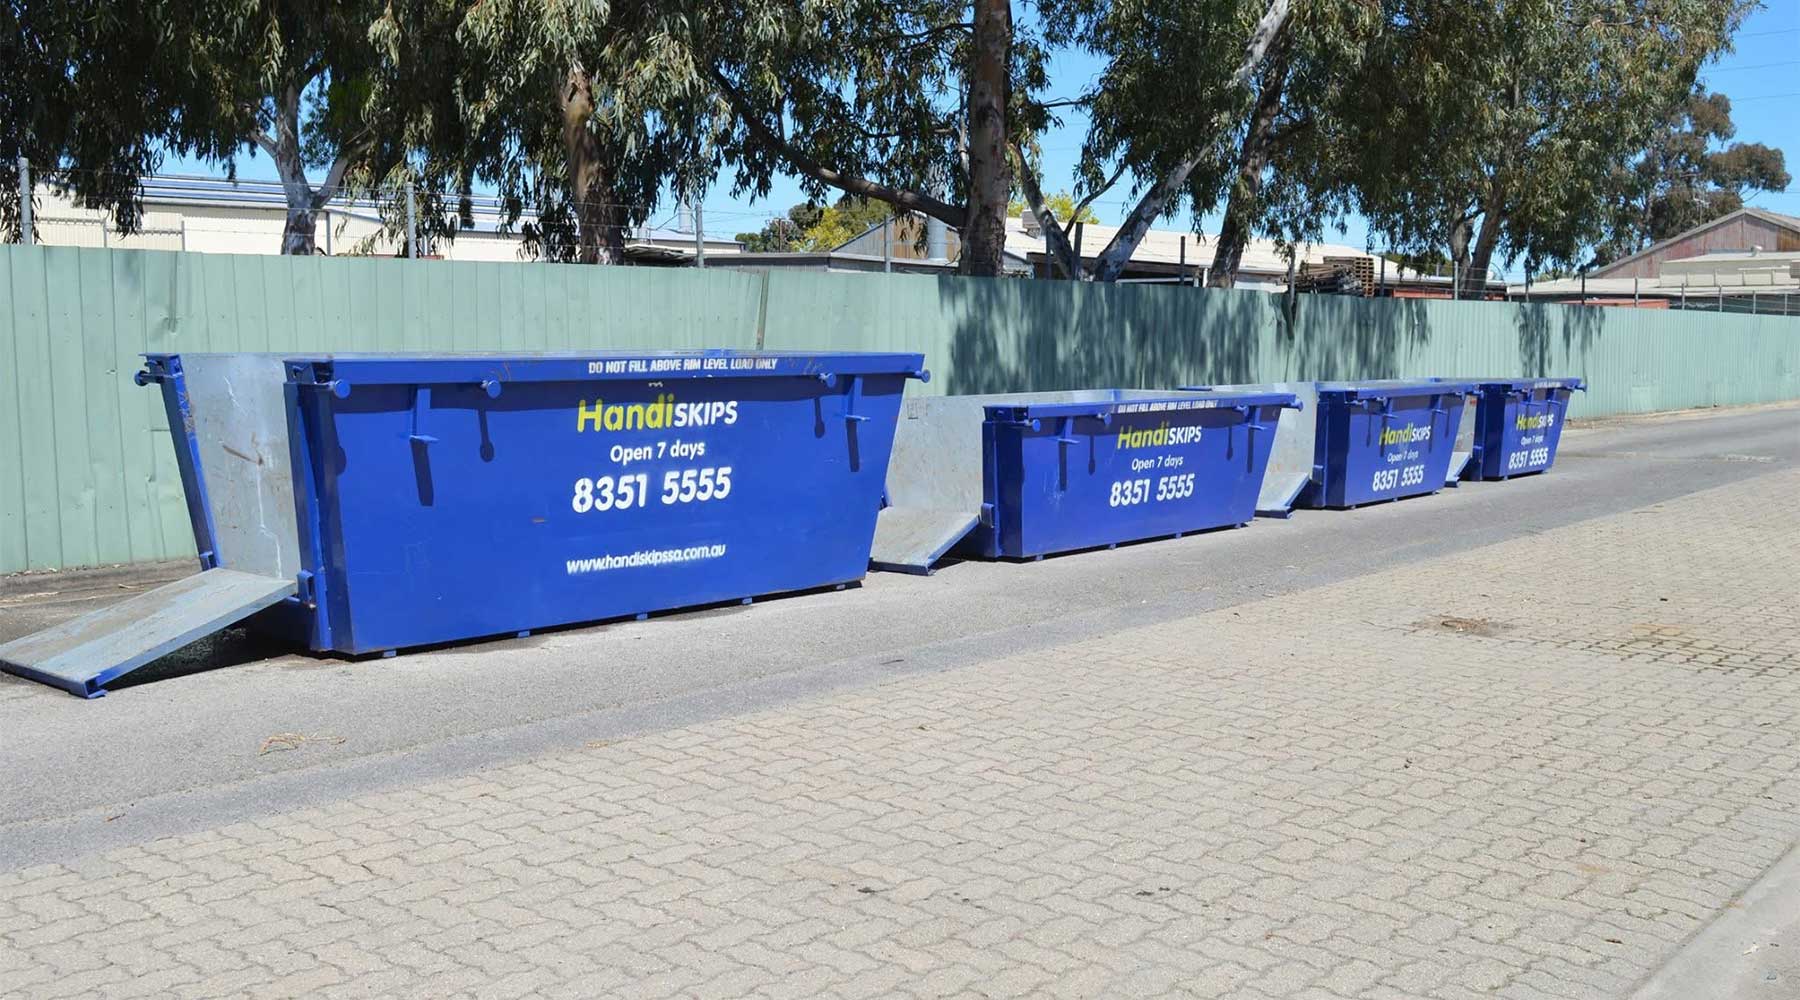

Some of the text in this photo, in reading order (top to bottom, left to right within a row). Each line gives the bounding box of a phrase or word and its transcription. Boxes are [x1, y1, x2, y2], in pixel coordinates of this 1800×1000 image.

[588, 358, 778, 374] DO NOT FILL ABOVE RIM LEVEL LOAD ONLY
[610, 439, 705, 466] Open 7 days
[1131, 453, 1183, 473] Open 7 days
[1508, 447, 1549, 470] 8351 5555
[572, 466, 732, 513] 8351 5555
[1110, 473, 1195, 507] 8351 5555
[1372, 464, 1425, 492] 8351 5555
[566, 544, 726, 575] www.handiskipssa.com.au
